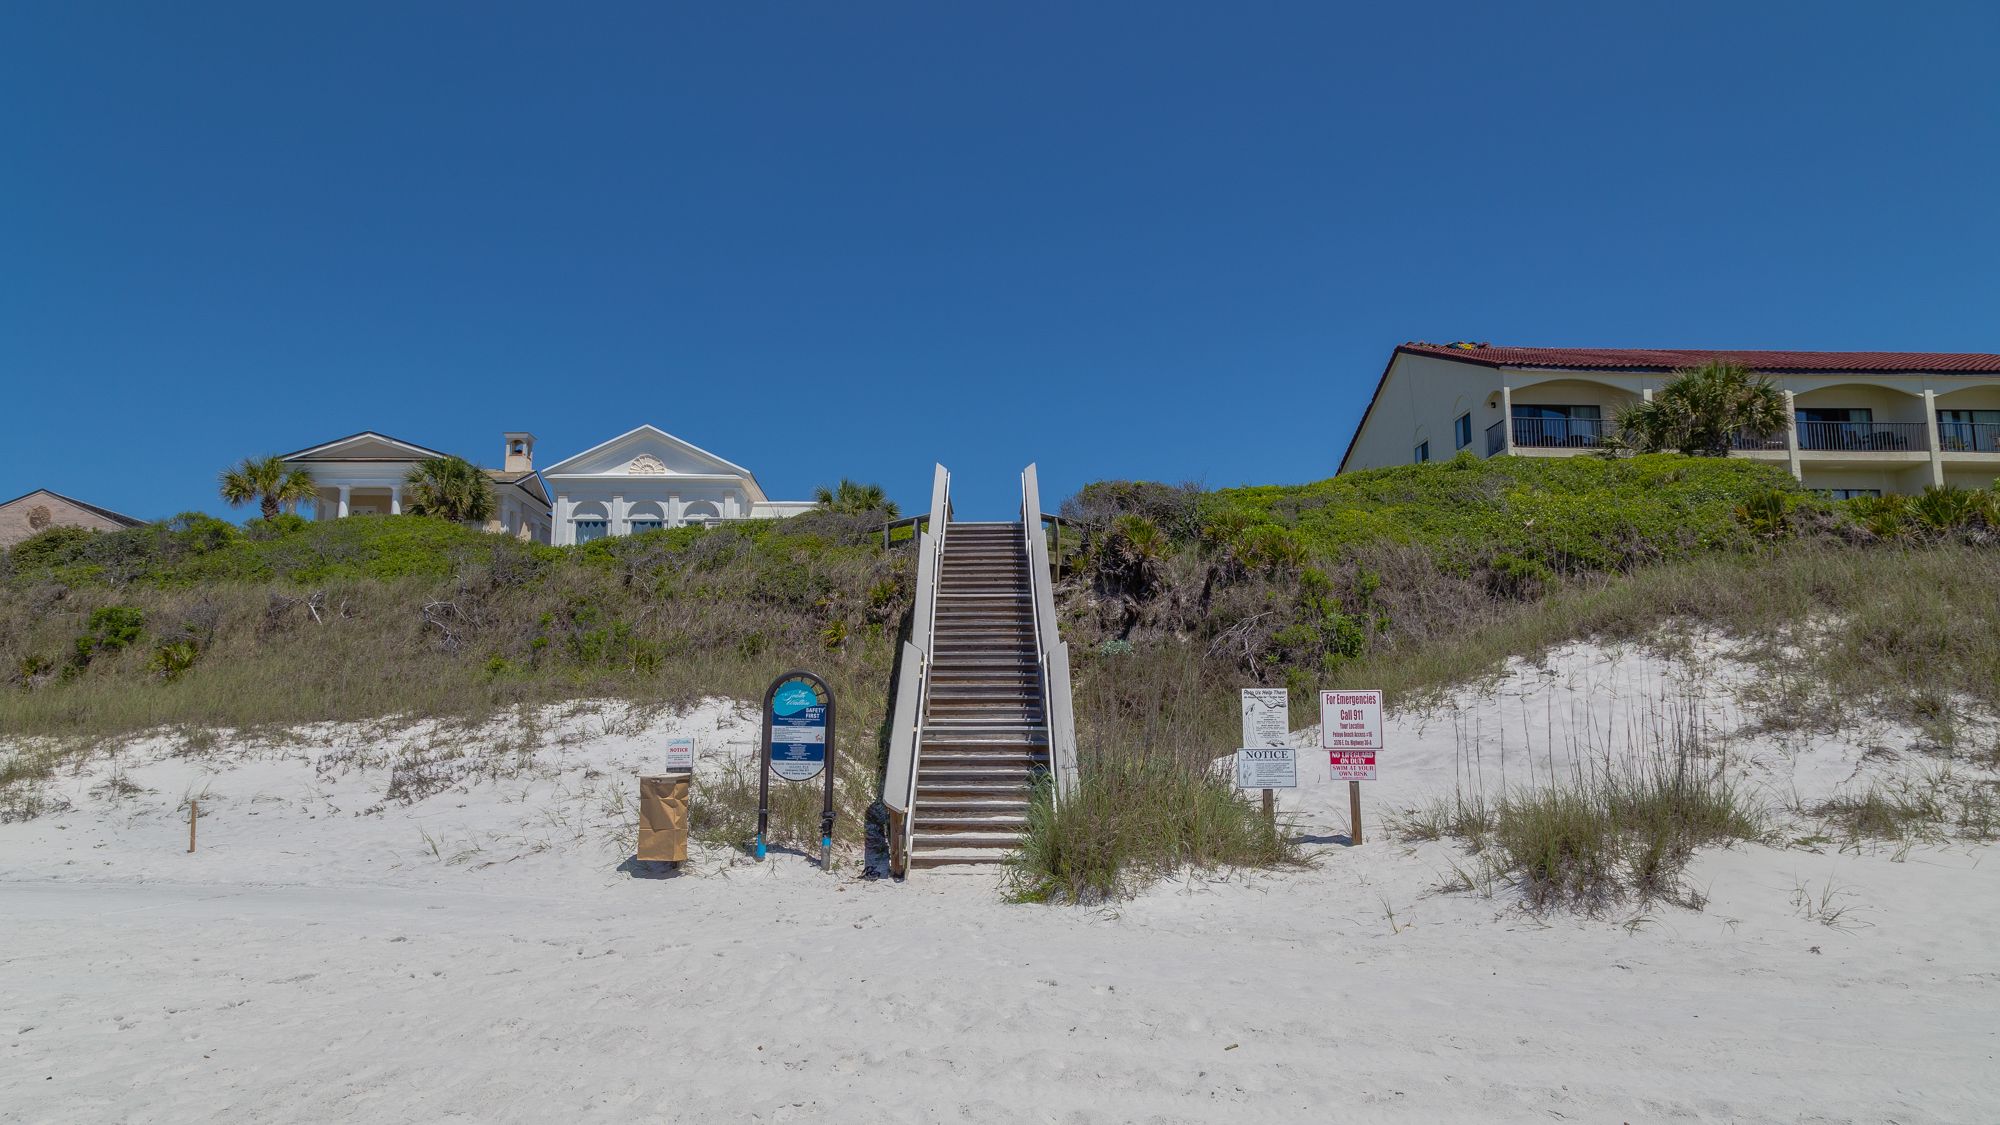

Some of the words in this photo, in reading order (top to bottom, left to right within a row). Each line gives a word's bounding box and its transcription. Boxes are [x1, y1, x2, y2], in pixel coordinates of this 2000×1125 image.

[1326, 694, 1336, 705] For
[1337, 694, 1377, 706] Emergencies
[1341, 709, 1353, 720] Call
[1353, 709, 1363, 720] 911
[1246, 751, 1289, 759] NOTICE
